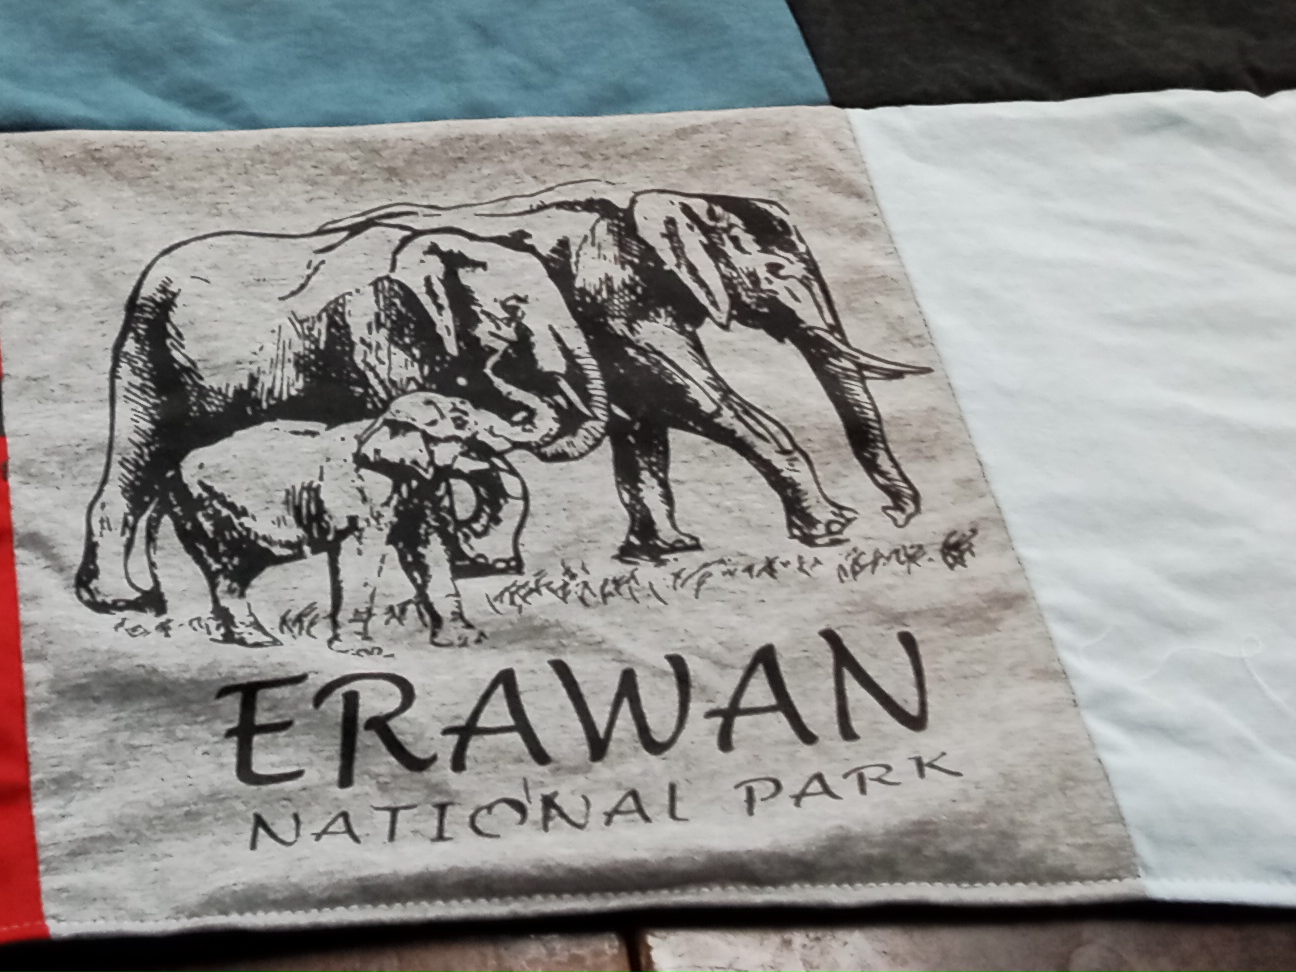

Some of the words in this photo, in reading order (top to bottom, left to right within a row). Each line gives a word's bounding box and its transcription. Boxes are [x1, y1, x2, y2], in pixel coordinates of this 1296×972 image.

[215, 628, 931, 790] ERAWAN
[249, 782, 689, 852] NATIONAL
[733, 750, 963, 816] PARK
